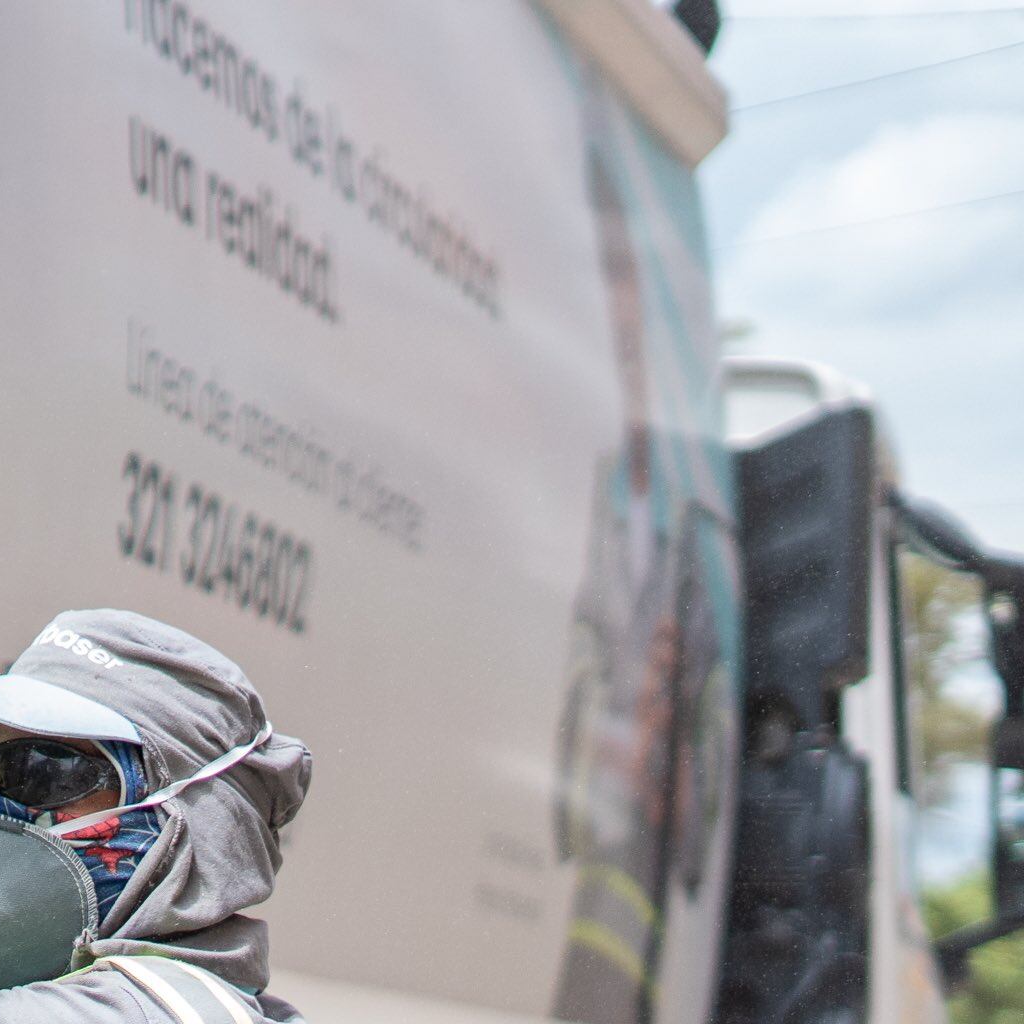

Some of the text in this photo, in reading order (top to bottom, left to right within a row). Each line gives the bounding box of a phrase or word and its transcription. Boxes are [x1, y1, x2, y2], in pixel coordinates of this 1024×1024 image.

[128, 115, 195, 228] una
[284, 76, 324, 177] de
[118, 451, 174, 573] 321
